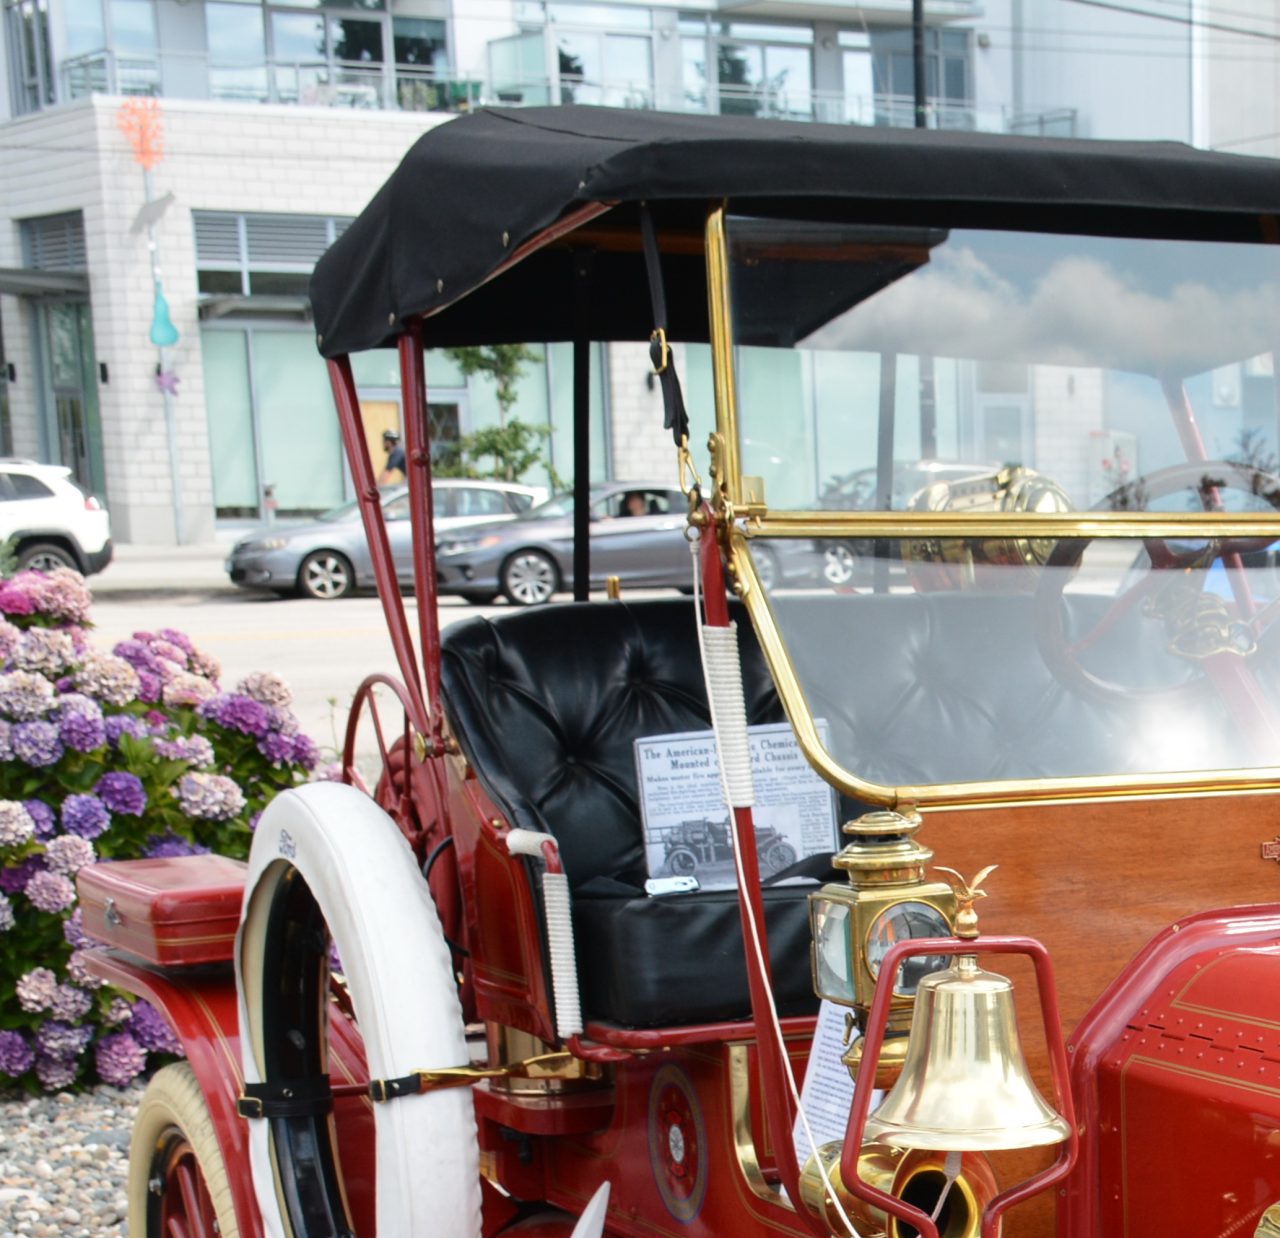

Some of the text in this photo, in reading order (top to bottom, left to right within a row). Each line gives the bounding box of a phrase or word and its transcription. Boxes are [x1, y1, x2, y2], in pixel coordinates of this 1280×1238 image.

[643, 748, 661, 760] The
[760, 737, 798, 750] Chemica
[671, 757, 710, 769] Mounted
[764, 751, 798, 762] Chassis
